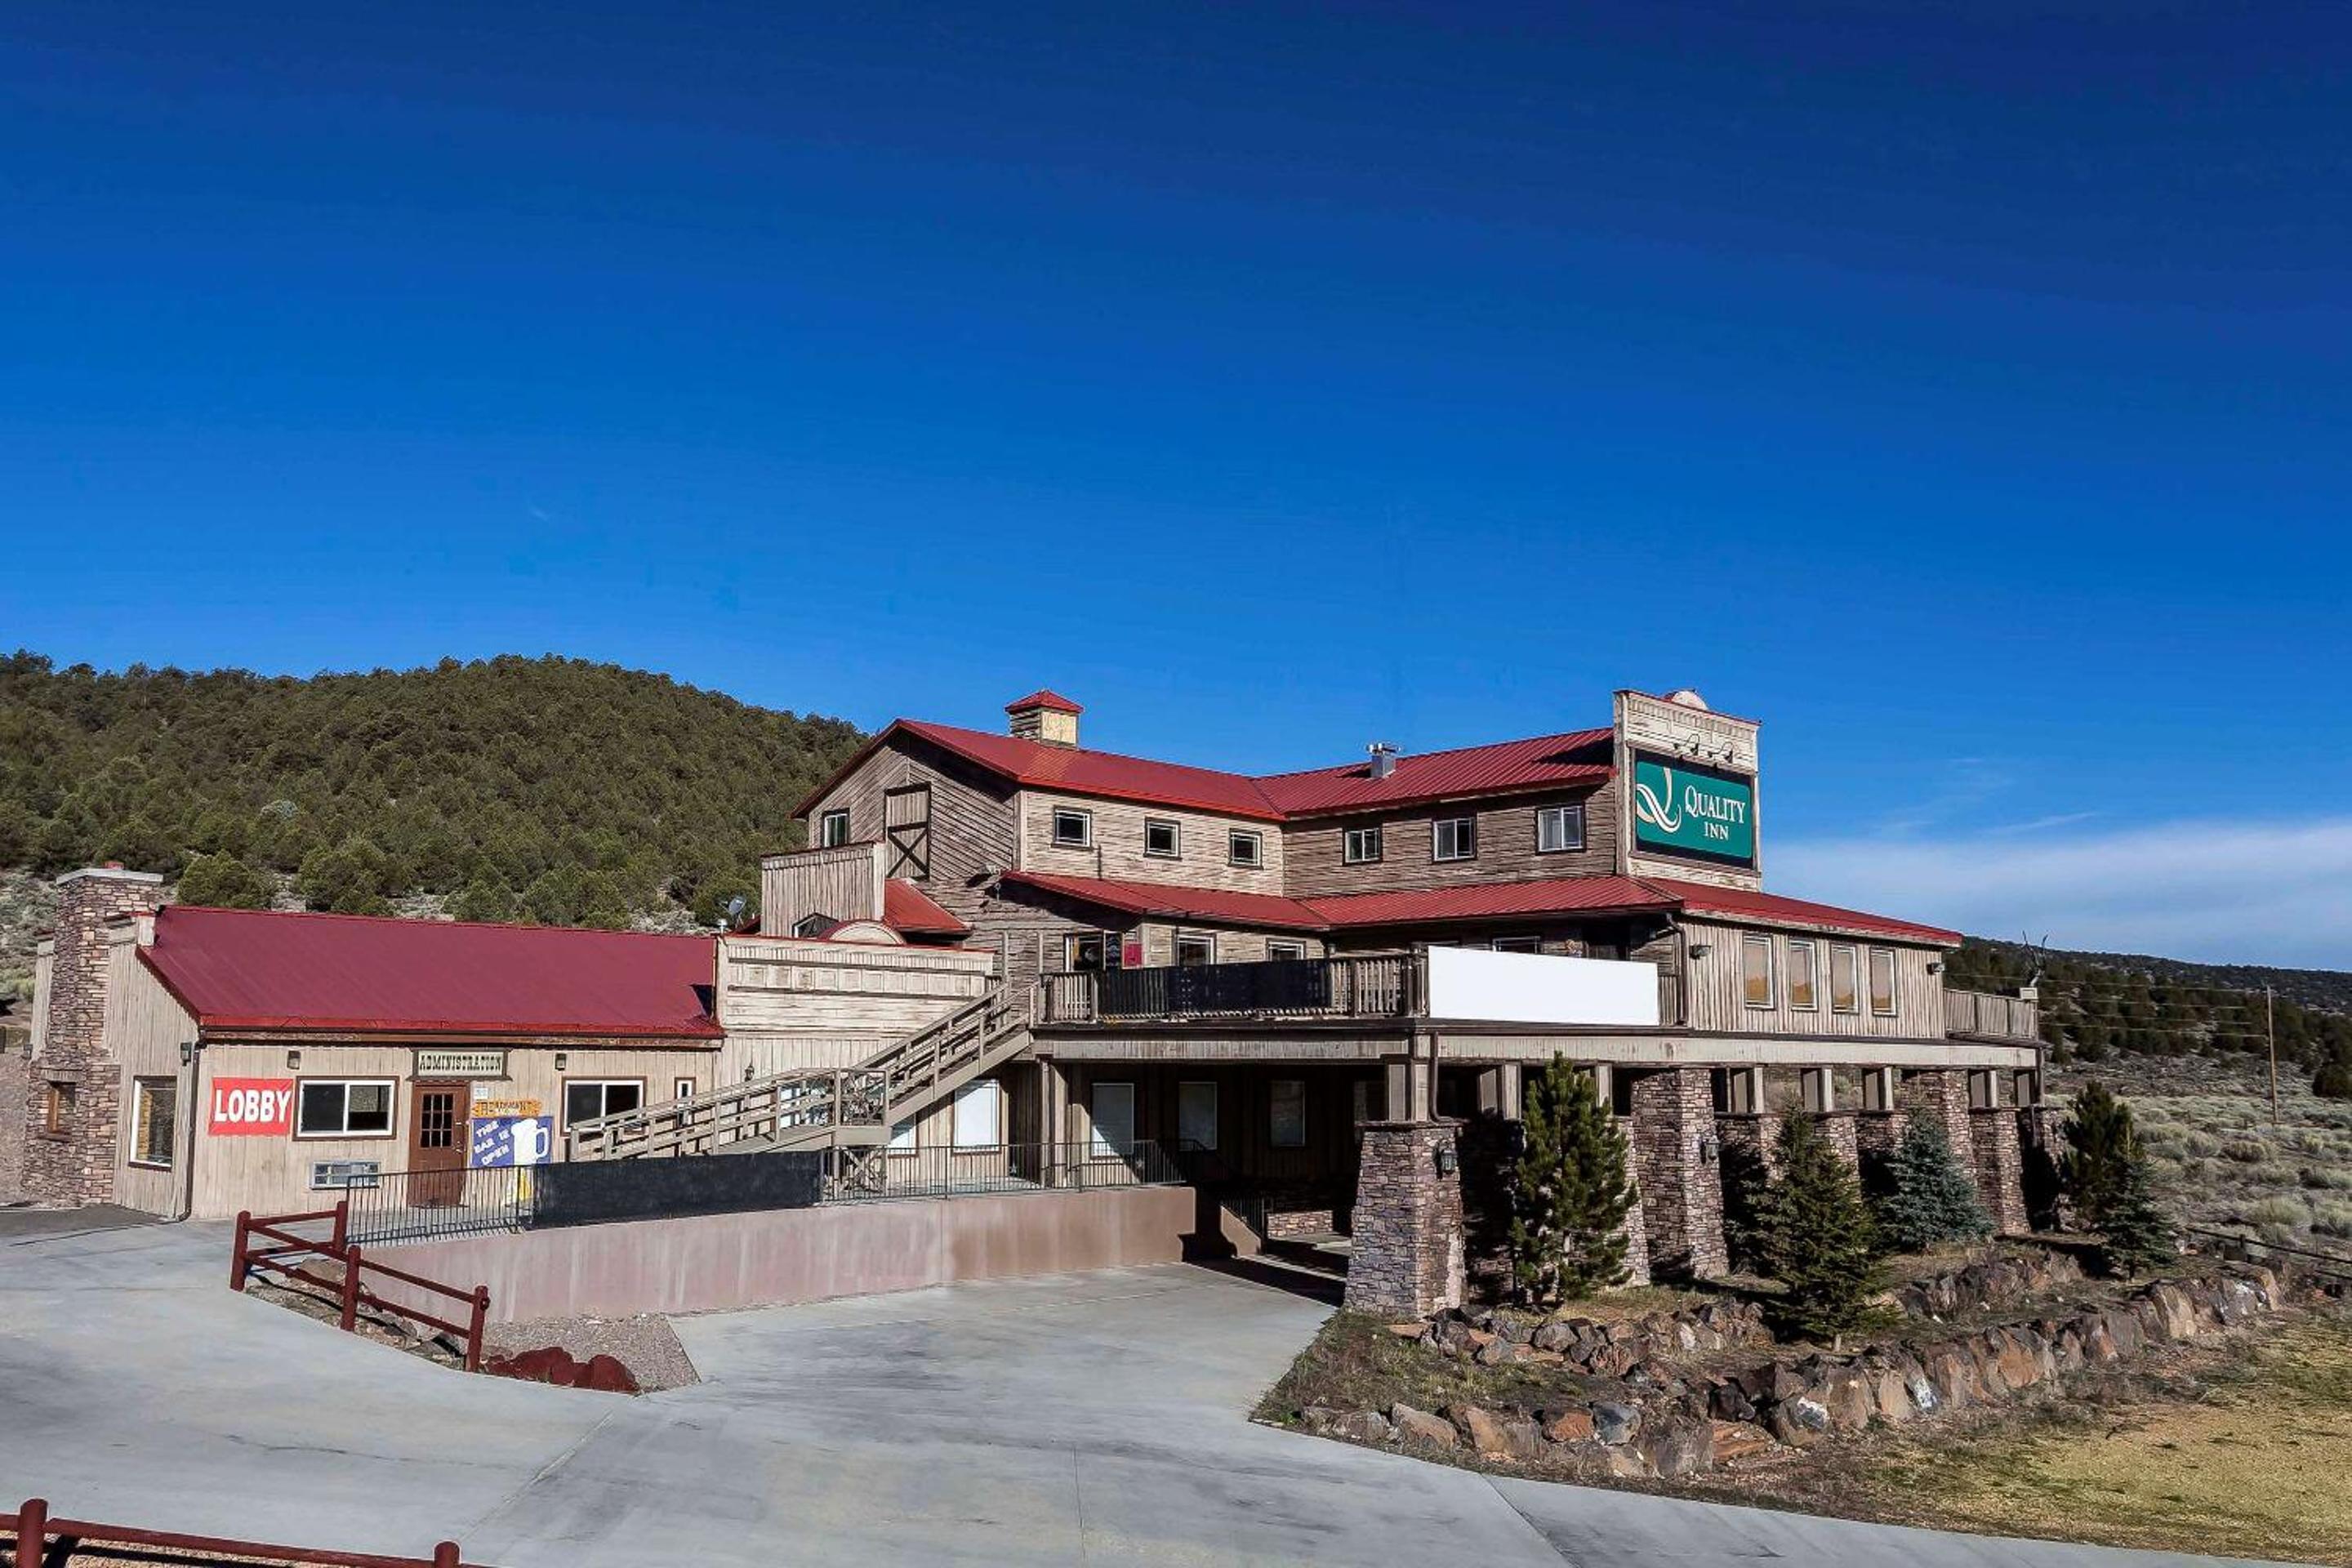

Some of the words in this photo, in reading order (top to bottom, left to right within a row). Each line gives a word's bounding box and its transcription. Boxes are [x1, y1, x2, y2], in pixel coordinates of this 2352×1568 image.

[1685, 785, 1746, 824] QUALITY
[1704, 821, 1729, 840] INN
[419, 1054, 501, 1071] ADMINISTRATION
[214, 1089, 292, 1123] LOBBY
[474, 1138, 495, 1154] BAR
[481, 1144, 510, 1165] OPEN
